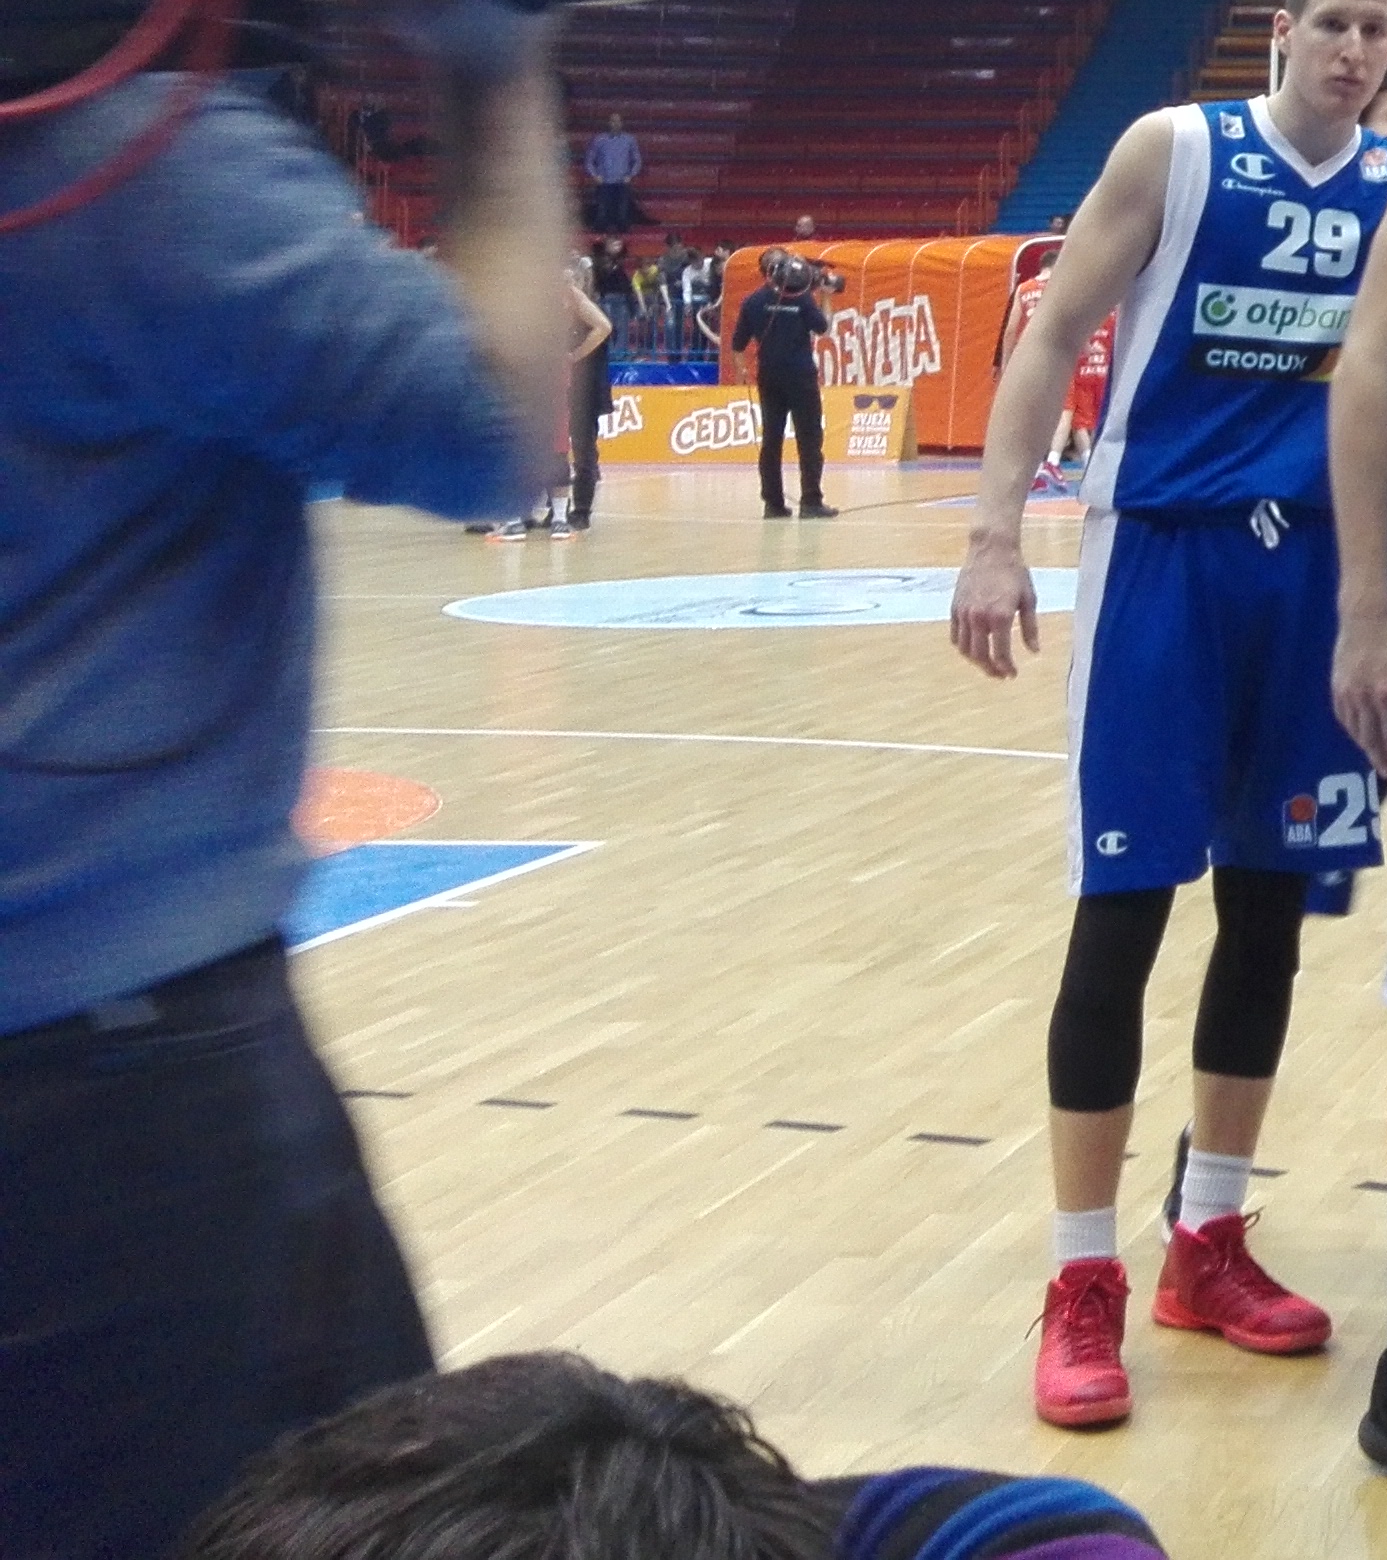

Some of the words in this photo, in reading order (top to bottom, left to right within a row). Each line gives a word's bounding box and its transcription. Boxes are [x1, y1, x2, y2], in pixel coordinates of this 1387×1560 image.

[1261, 200, 1361, 279] 29
[811, 295, 941, 386] DEVITA
[1247, 297, 1351, 336] otpba
[1206, 348, 1307, 372] CRODUX
[1318, 771, 1381, 848] 2
